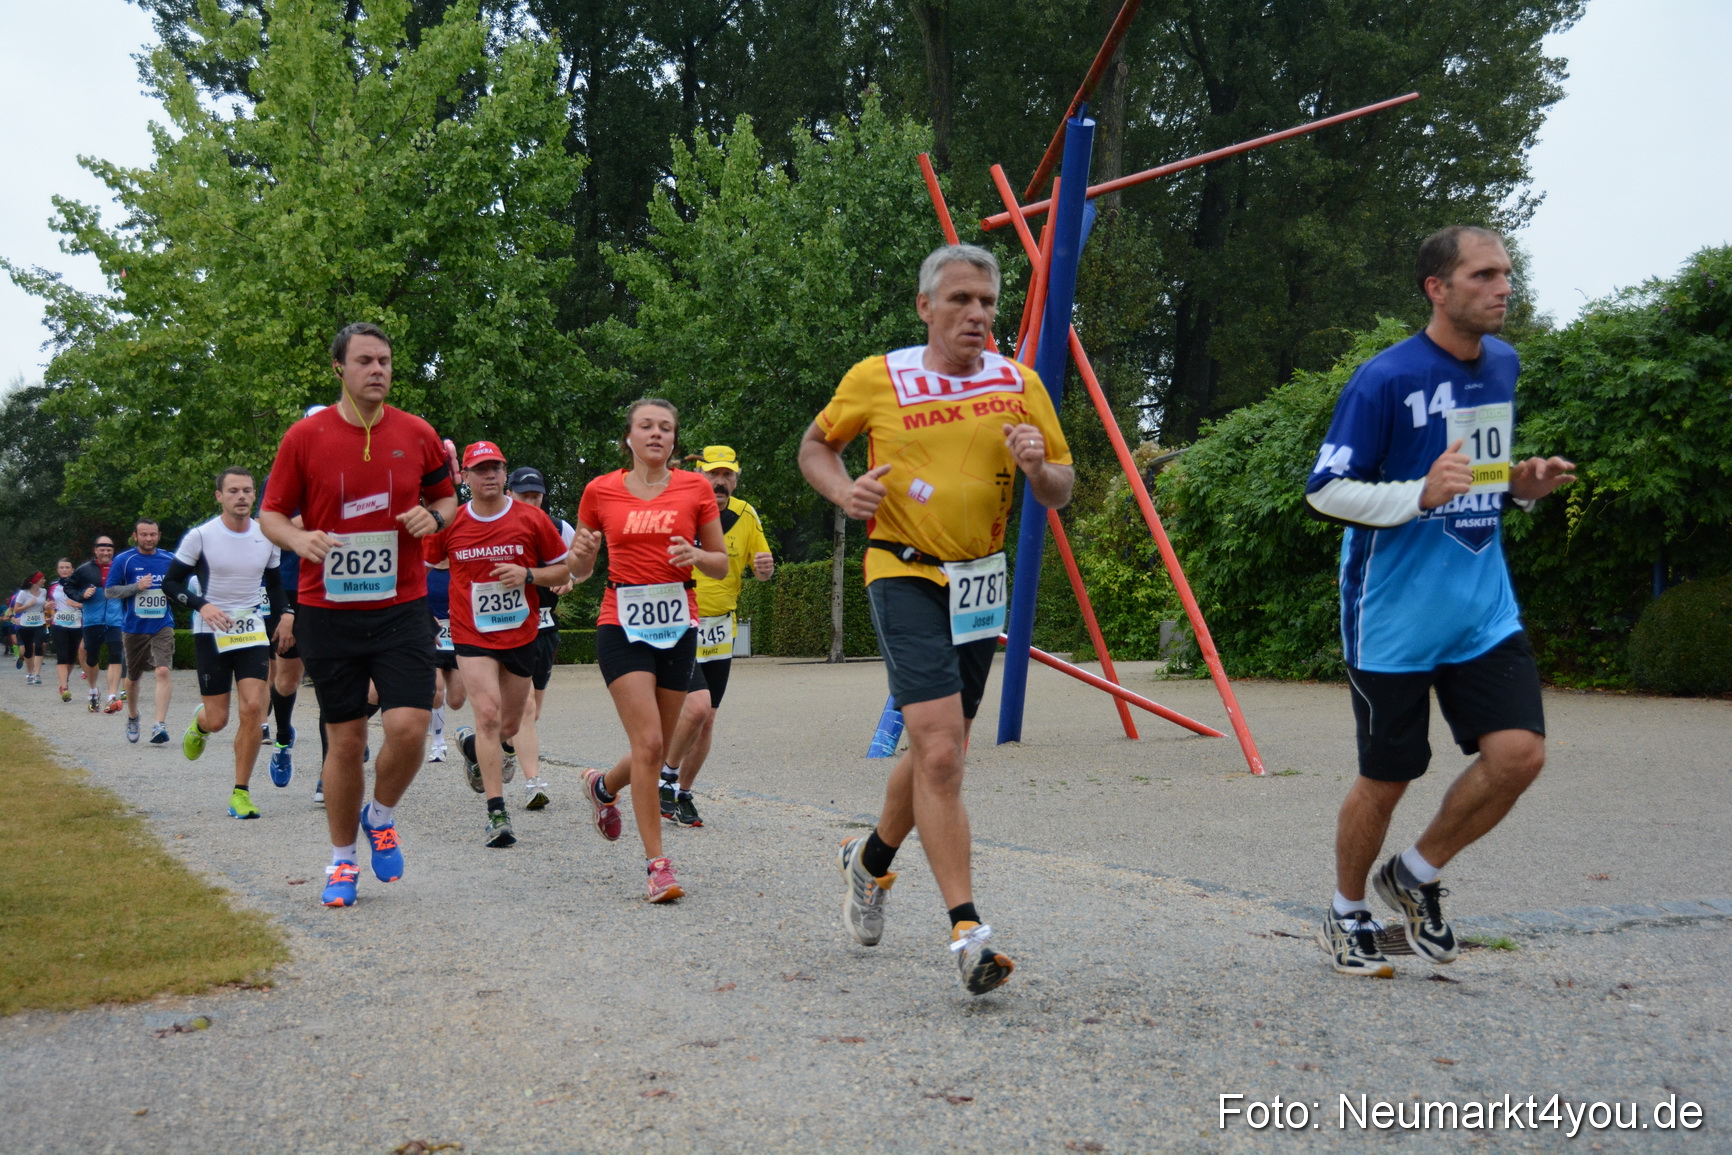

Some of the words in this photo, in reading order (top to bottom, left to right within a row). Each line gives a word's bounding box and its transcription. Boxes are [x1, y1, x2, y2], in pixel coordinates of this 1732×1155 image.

[1404, 381, 1456, 428] 14
[902, 405, 965, 431] MAX
[1470, 427, 1501, 459] 10
[1314, 443, 1352, 475] 14
[356, 500, 377, 512] DEHN
[622, 510, 678, 534] NIKE
[1454, 517, 1498, 528] BASKETS
[455, 545, 514, 560] NEUMARKT
[331, 548, 392, 576] 2623
[343, 581, 380, 592] Markus
[958, 571, 1004, 609] 2787
[139, 596, 166, 608] 2906
[478, 589, 523, 613] 2352
[491, 615, 516, 624] Rainer
[626, 598, 684, 626] 2802
[972, 613, 994, 628] Josef
[229, 634, 257, 644] Andreas
[440, 627, 453, 638] 25
[638, 630, 677, 641] Veronika
[698, 625, 725, 645] 145
